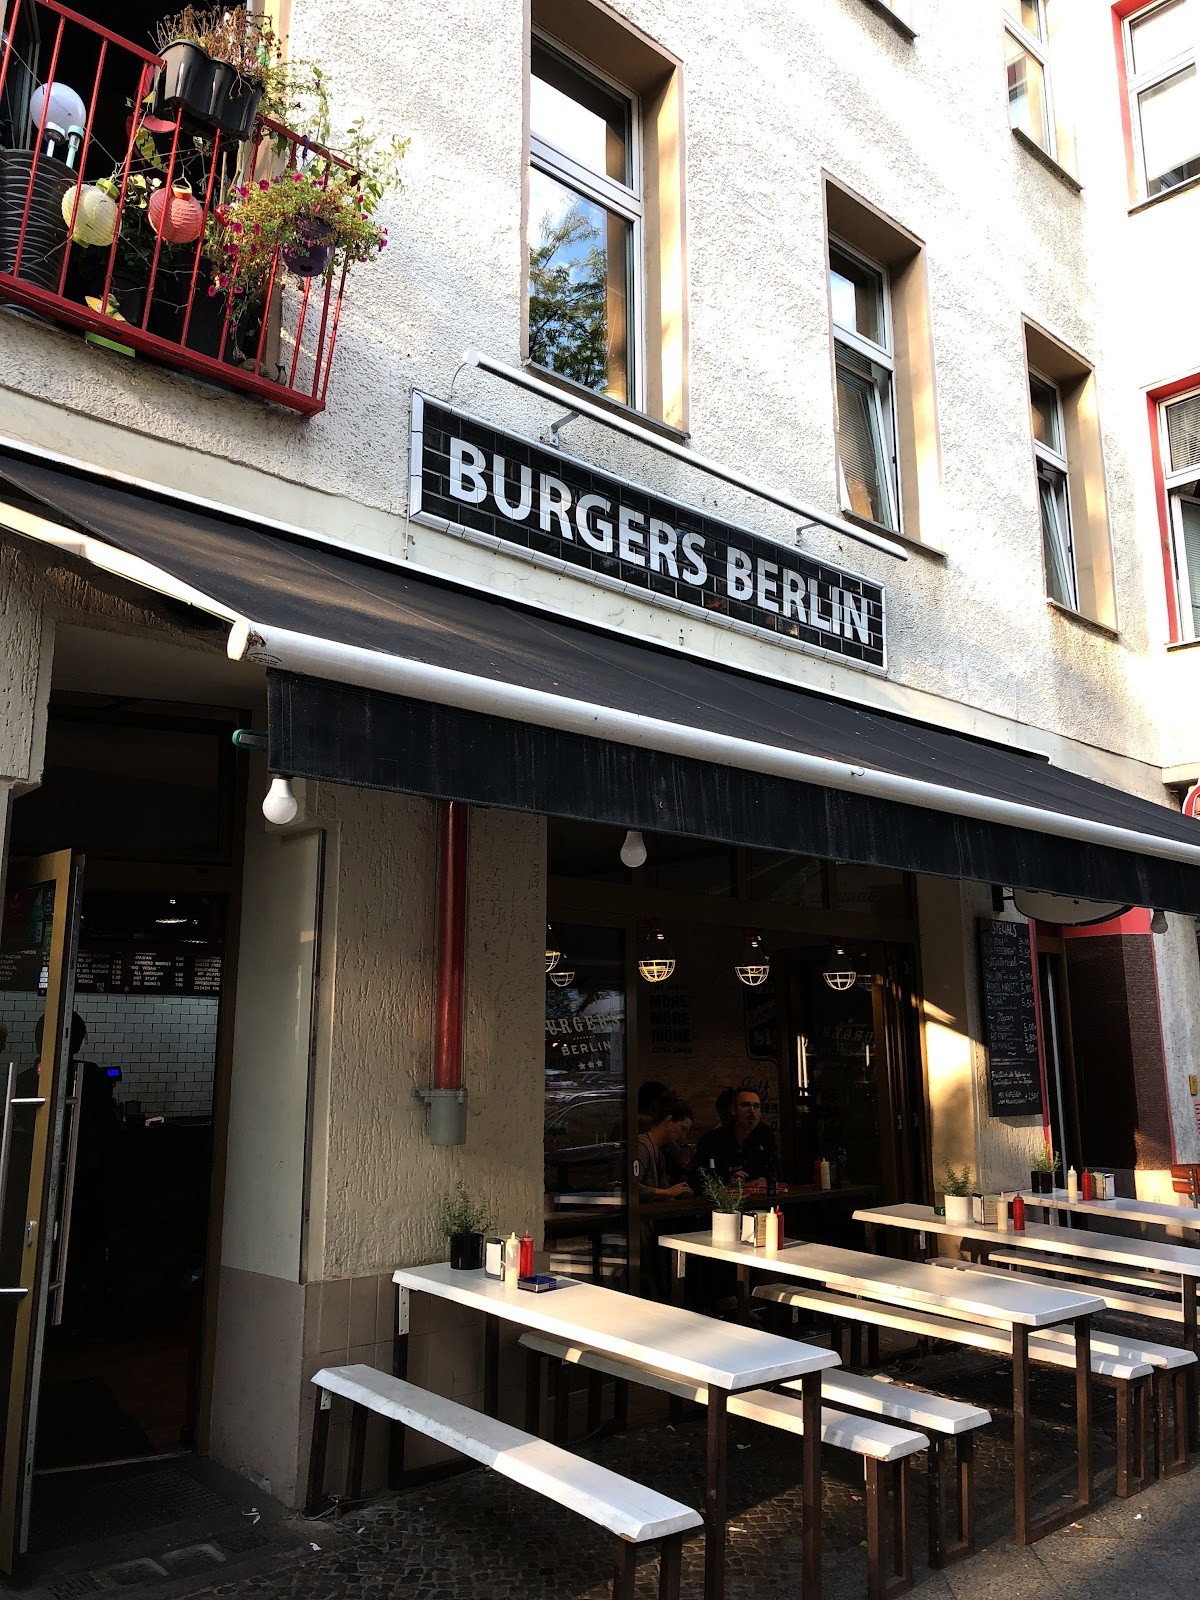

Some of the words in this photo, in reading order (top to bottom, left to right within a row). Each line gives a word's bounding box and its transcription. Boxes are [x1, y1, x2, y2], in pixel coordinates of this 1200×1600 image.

[449, 437, 708, 588] BURGERS
[727, 546, 872, 646] BERLIN
[992, 922, 1017, 938] SPECIALS
[545, 1014, 621, 1035] URGERS
[650, 1012, 690, 1025] MORE
[651, 1029, 691, 1042] MORE
[561, 1040, 612, 1056] BERLIN
